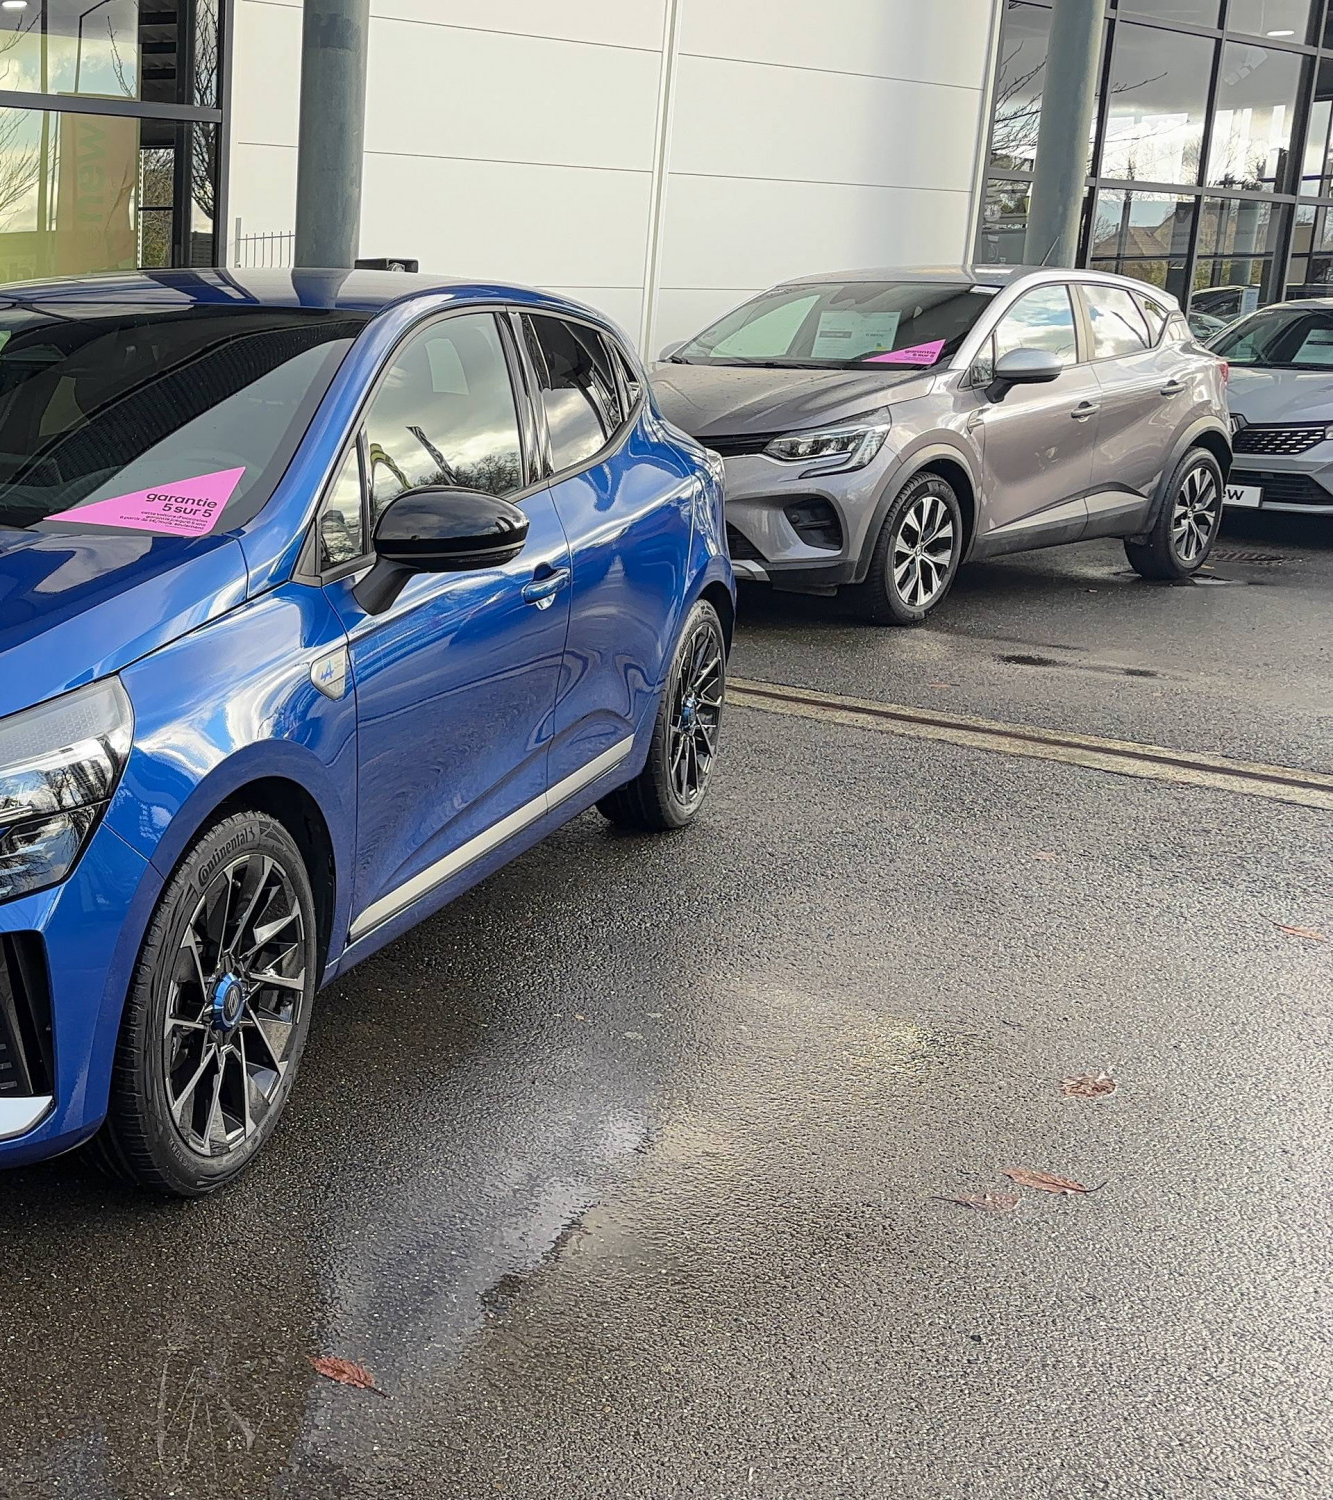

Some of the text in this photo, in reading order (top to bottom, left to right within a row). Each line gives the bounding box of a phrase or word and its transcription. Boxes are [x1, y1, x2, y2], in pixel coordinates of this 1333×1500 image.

[146, 493, 217, 508] garantie
[162, 503, 213, 518] 5 sur 5
[198, 828, 247, 887] Continental
